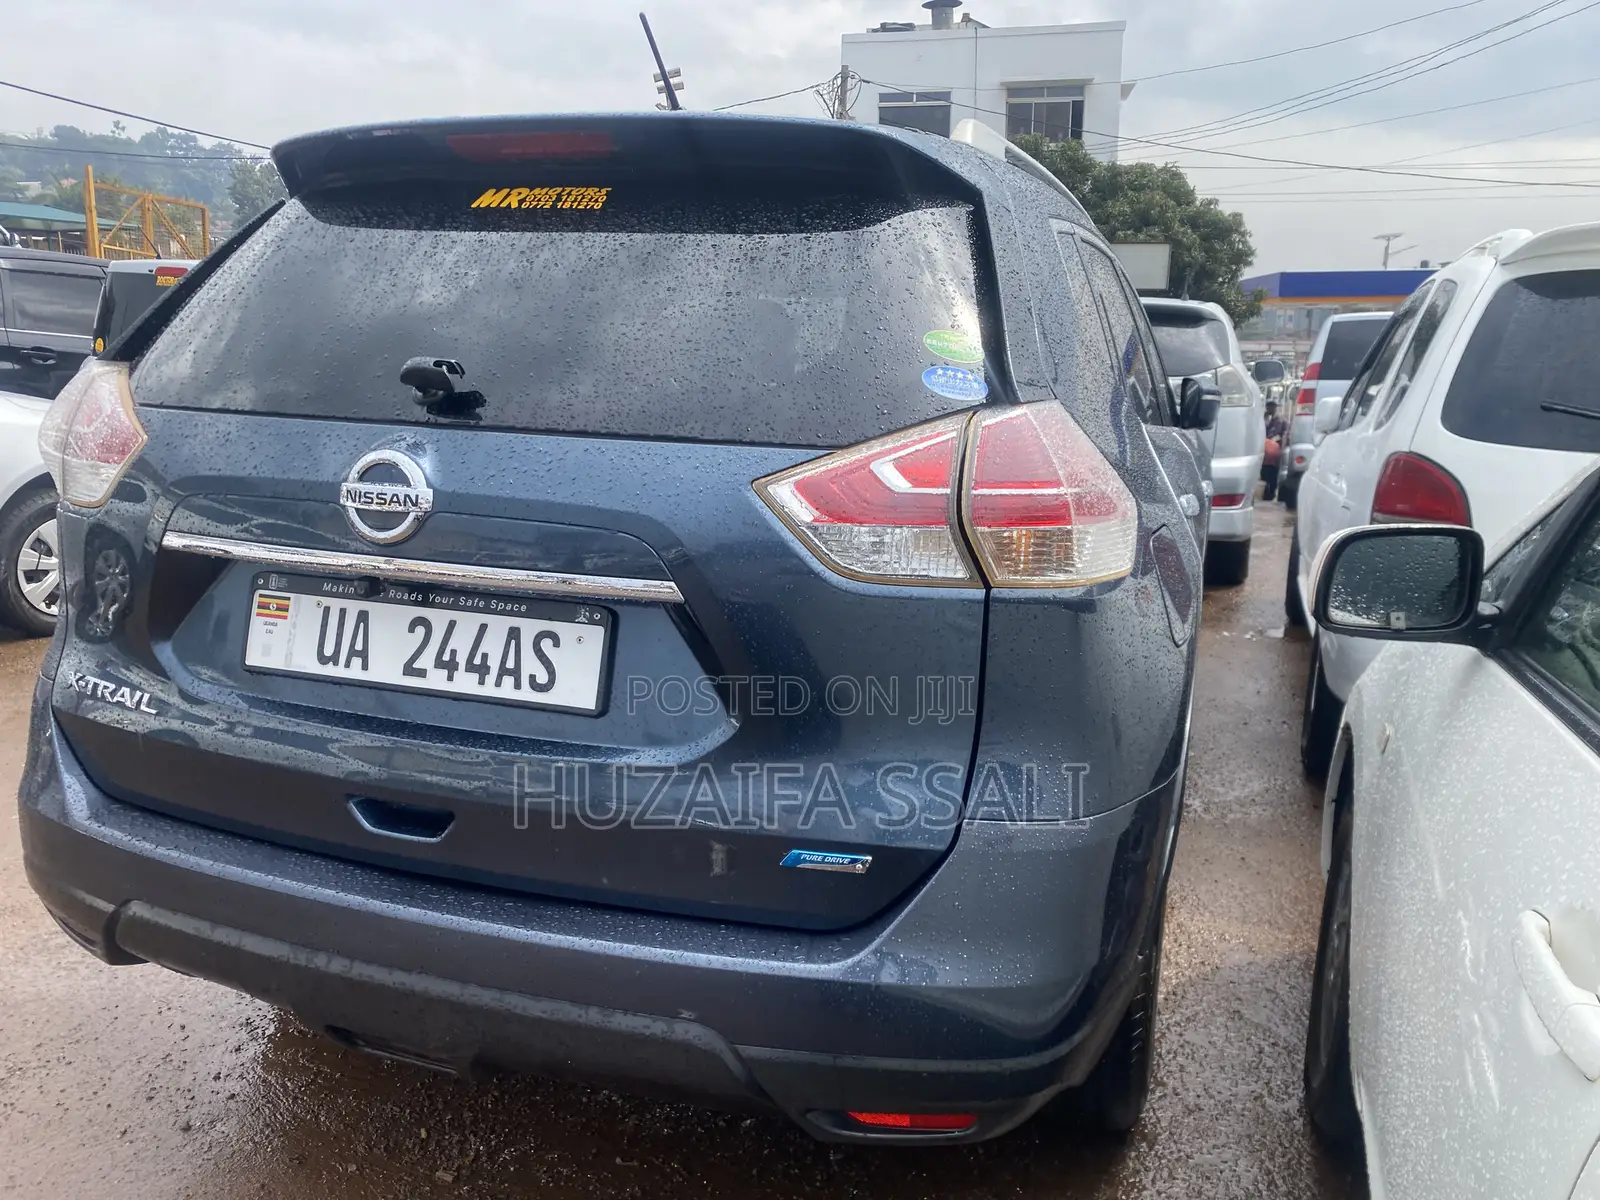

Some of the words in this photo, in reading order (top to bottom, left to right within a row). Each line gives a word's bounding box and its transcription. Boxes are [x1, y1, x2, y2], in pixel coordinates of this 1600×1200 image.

[471, 188, 530, 208] MR
[528, 187, 612, 195] MOTORS
[521, 201, 551, 209] 0772
[346, 489, 419, 507] NISSAN
[322, 582, 356, 594] Makin
[388, 589, 423, 601] Roads
[428, 593, 454, 604] Your
[459, 597, 485, 608] Safe
[490, 600, 527, 611] Space
[316, 605, 370, 671] UA
[402, 616, 561, 693] 244AS
[68, 671, 159, 714] X-TRAIL
[800, 853, 823, 862] PURE
[824, 856, 851, 864] DRIVE
